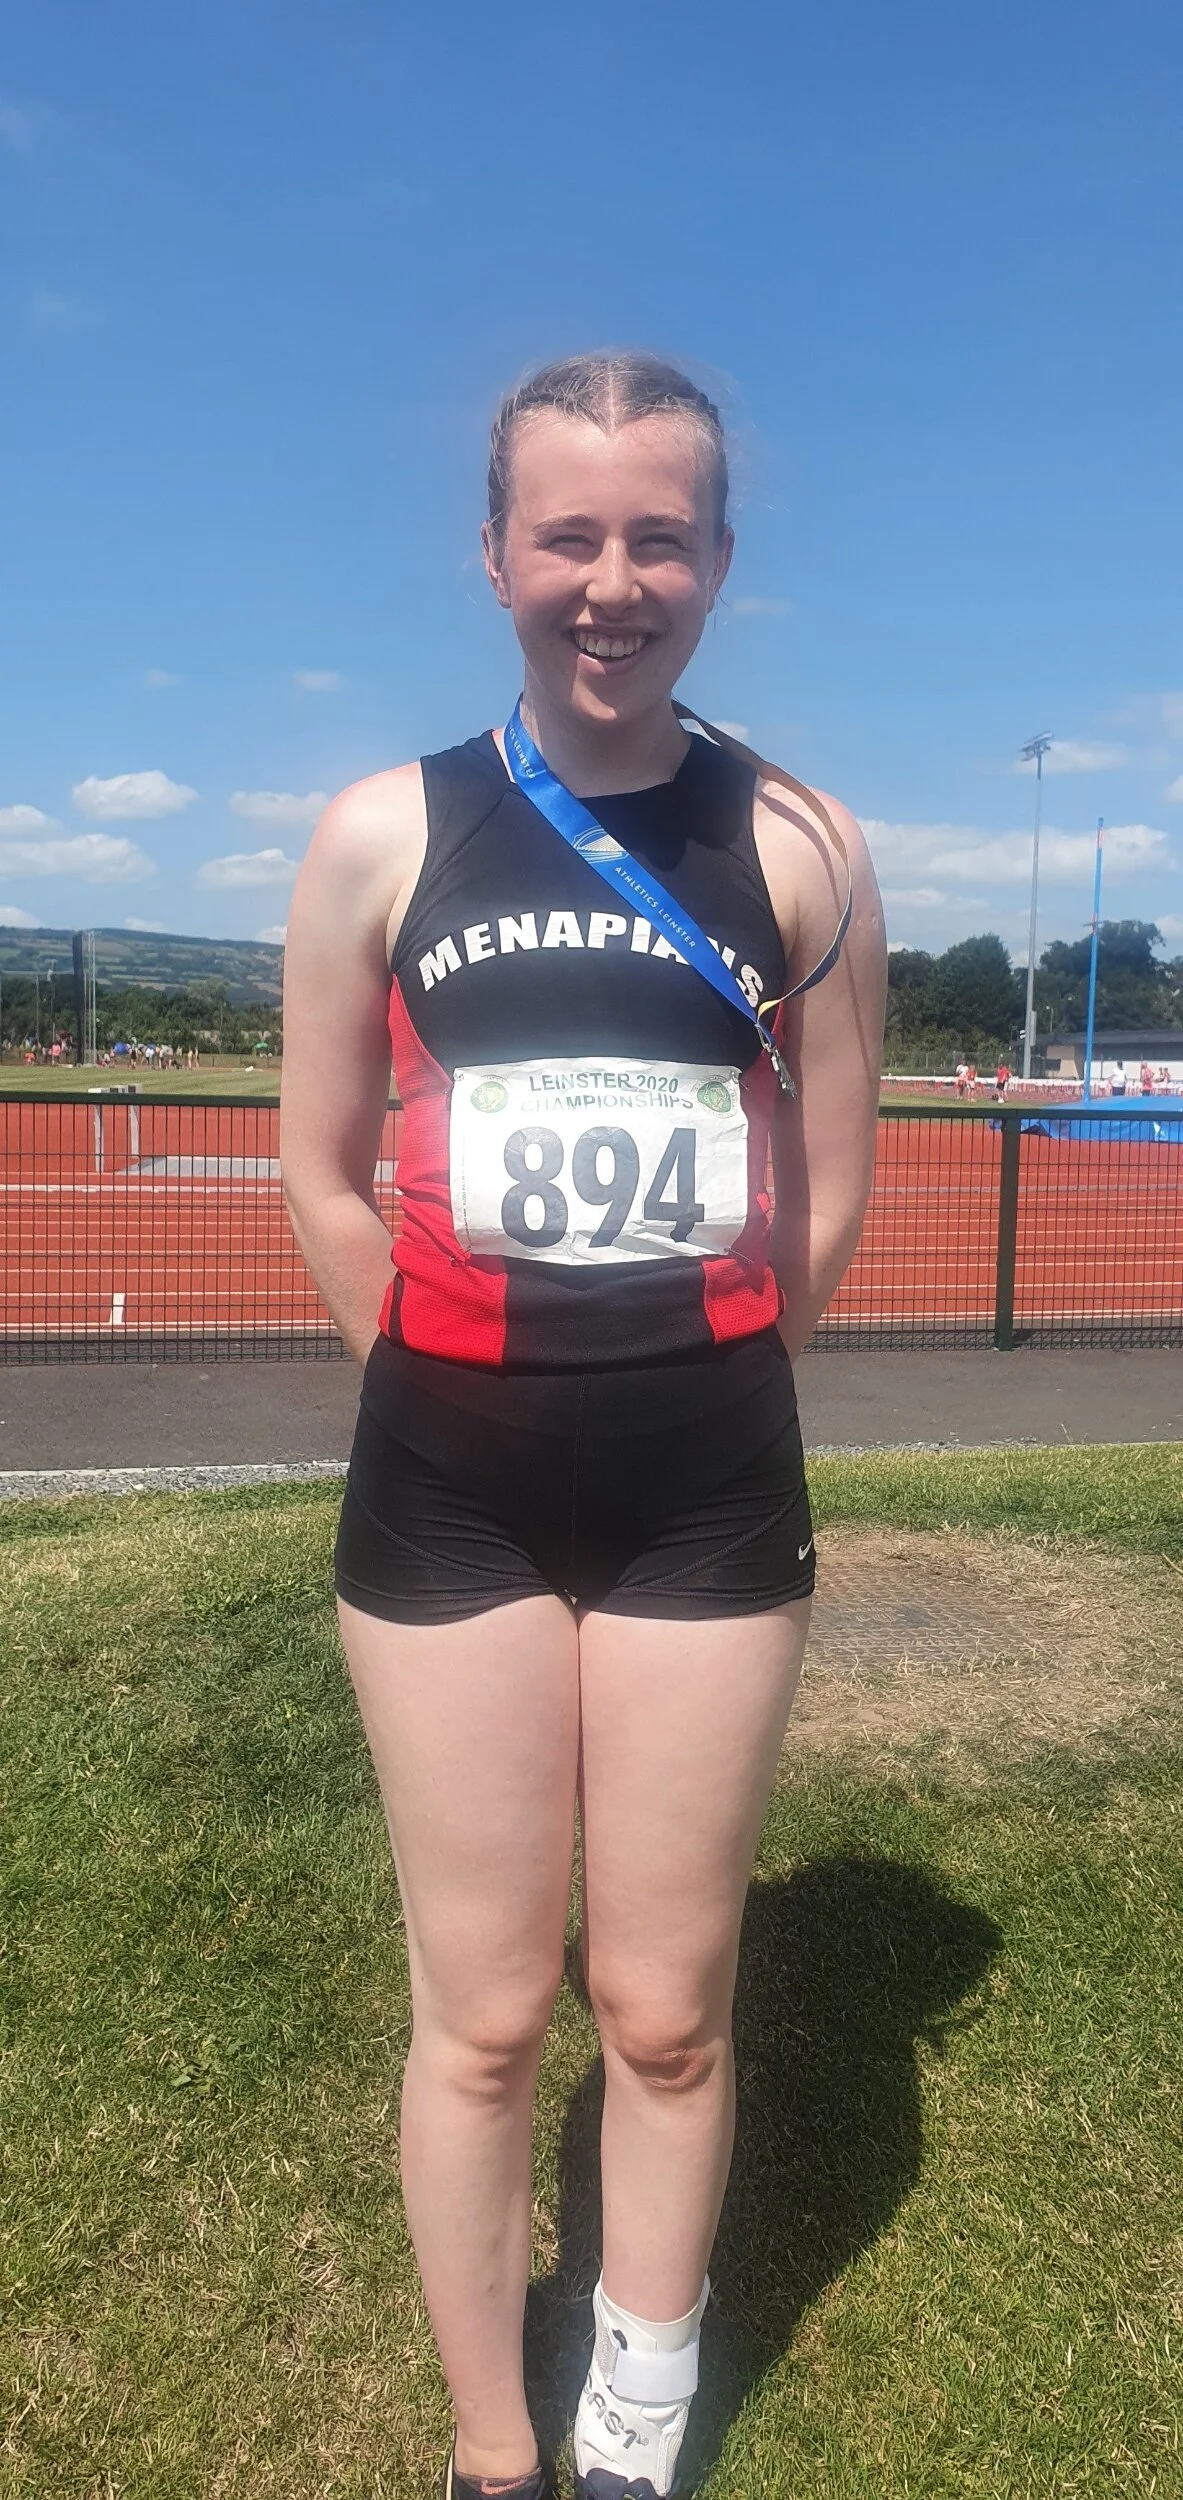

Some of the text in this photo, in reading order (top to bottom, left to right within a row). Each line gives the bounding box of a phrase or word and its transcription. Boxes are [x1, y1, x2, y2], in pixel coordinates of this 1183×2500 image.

[614, 866, 696, 948] ATHLETICS LEINSTER
[520, 1092, 694, 1112] CHAMPIONSHIPS
[529, 1072, 633, 1092] LEINSTER
[636, 1074, 679, 1093] 2020
[501, 1126, 704, 1248] 894
